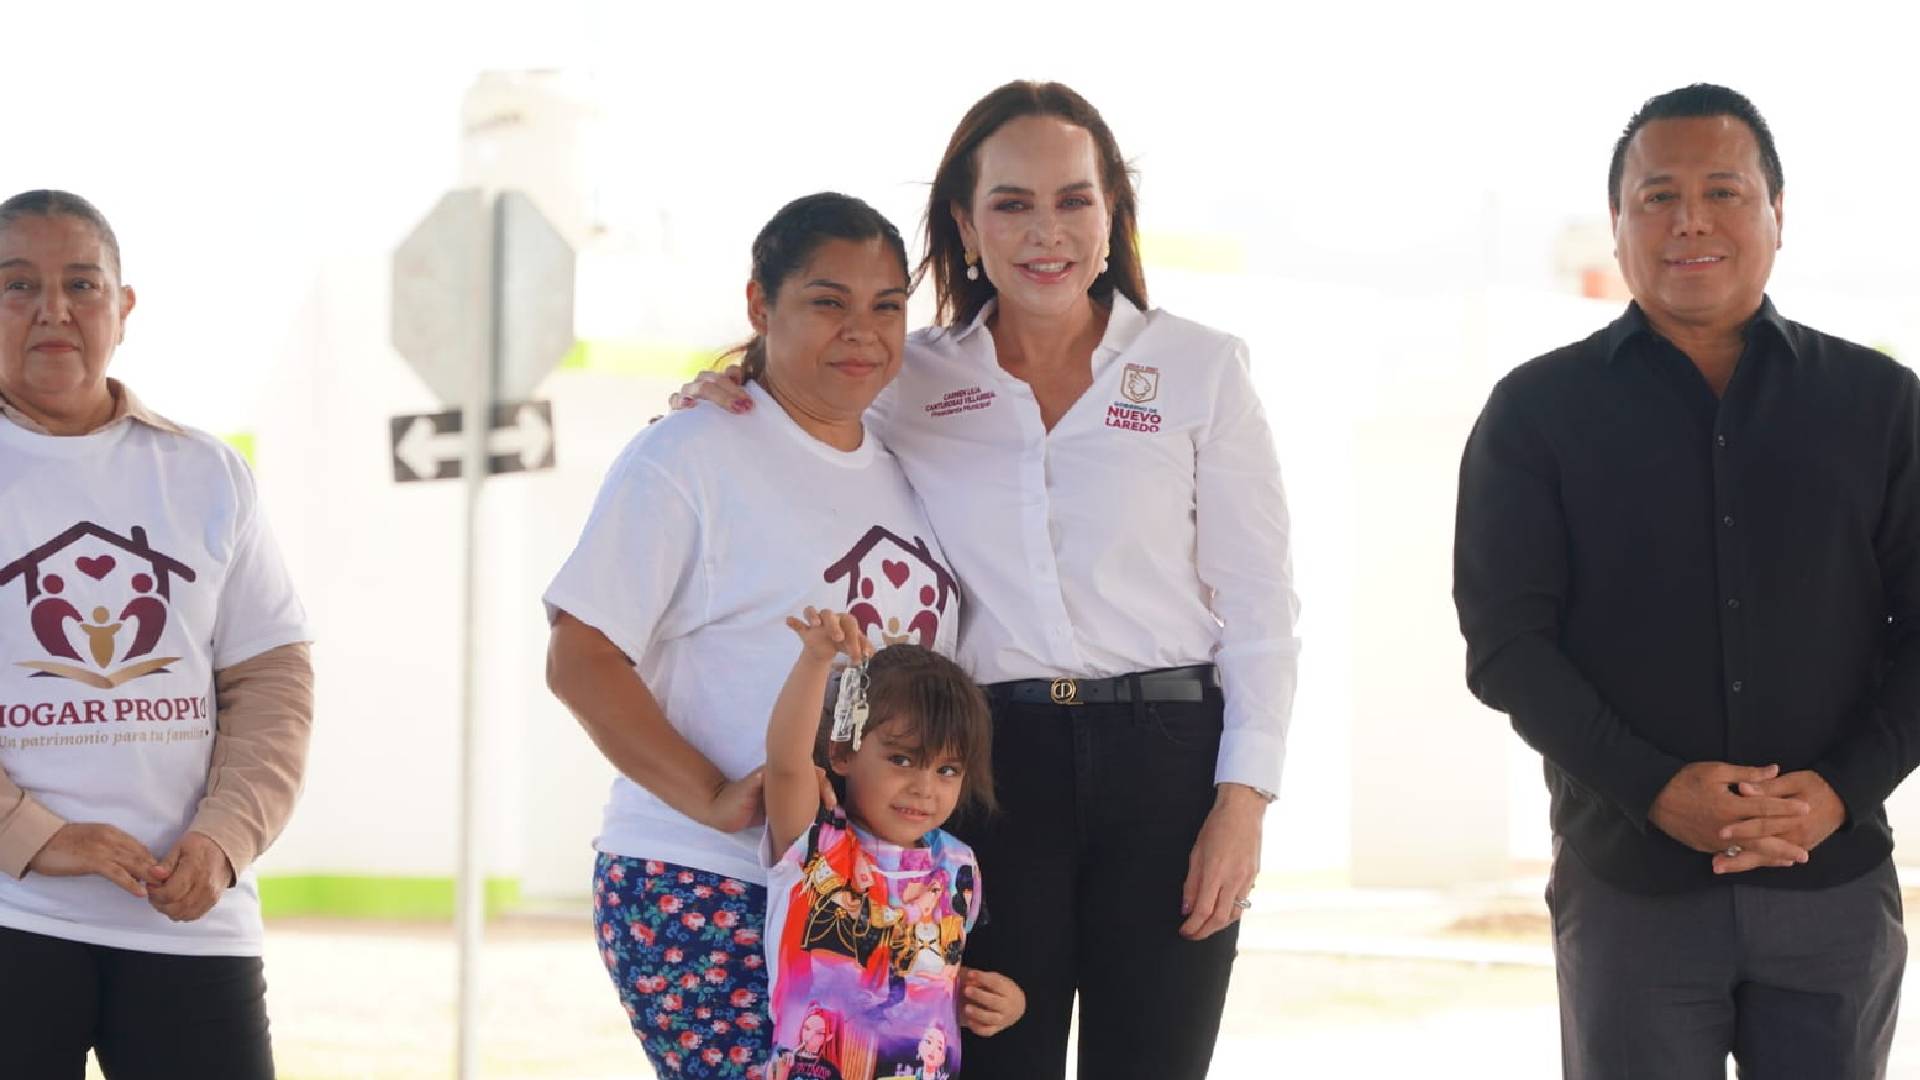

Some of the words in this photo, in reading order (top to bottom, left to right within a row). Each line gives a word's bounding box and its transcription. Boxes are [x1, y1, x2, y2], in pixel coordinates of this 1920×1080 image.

[1107, 405, 1162, 424] NUEVO
[1105, 418, 1161, 433] LAREDO
[21, 731, 108, 750] patrimonio
[112, 731, 147, 746] para
[150, 730, 164, 742] tu
